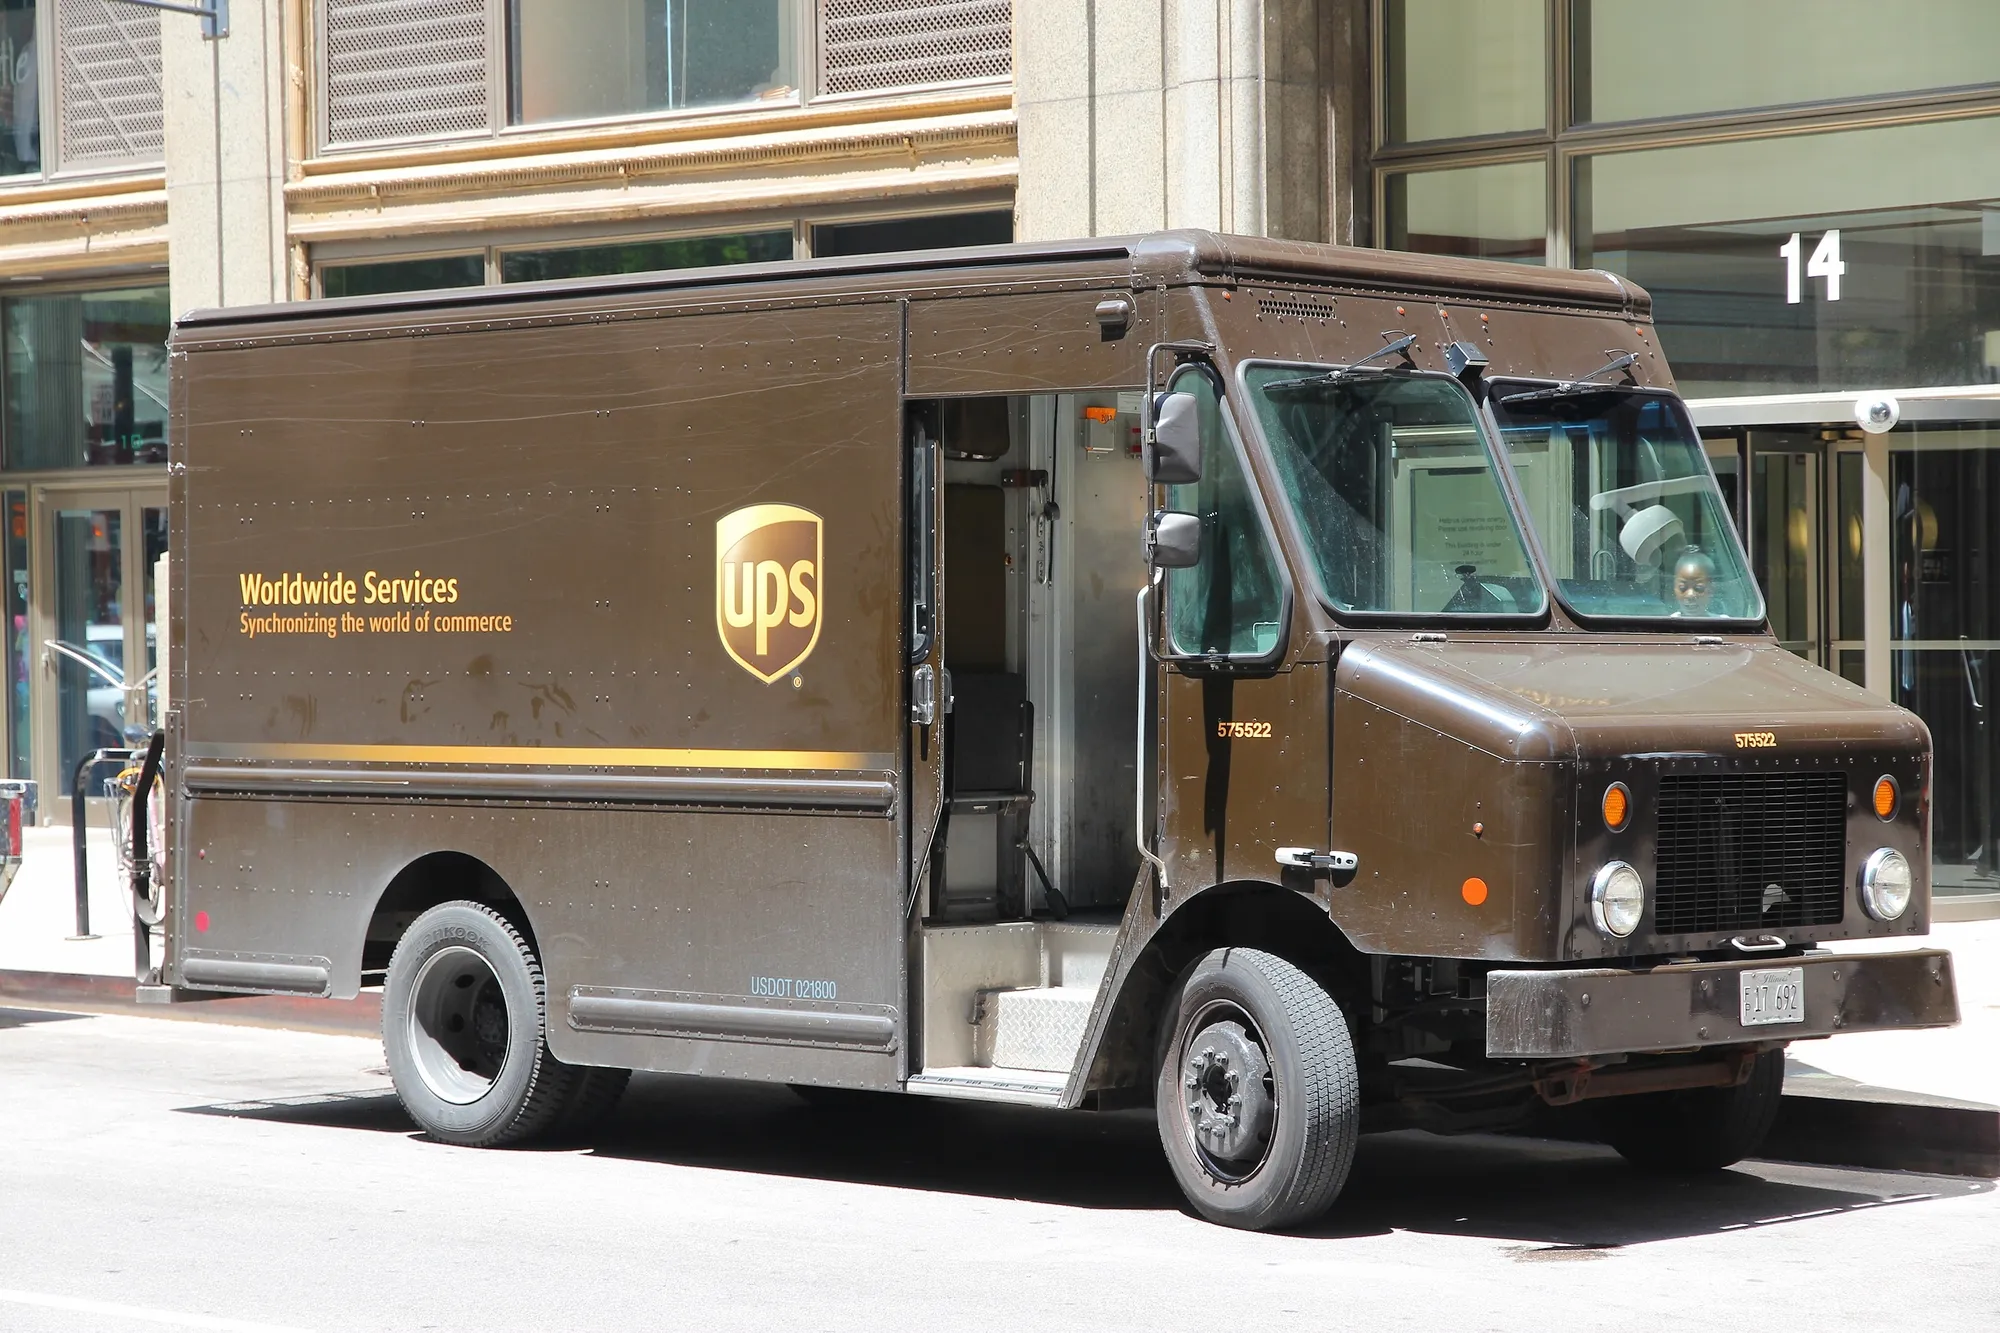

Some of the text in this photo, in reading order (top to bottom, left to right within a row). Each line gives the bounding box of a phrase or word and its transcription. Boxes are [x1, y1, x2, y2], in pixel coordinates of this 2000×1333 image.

[1780, 228, 1845, 304] 14
[239, 570, 458, 605] Worldwide Services
[724, 559, 816, 656] ups
[240, 611, 512, 639] Synchronizing the world of commerce
[1217, 722, 1272, 738] 575522
[1734, 732, 1777, 748] 575522
[751, 976, 836, 999] USDOT 021800
[1762, 973, 1788, 984] Illinois
[1754, 985, 1768, 1012] 17
[1775, 984, 1797, 1010] 692
